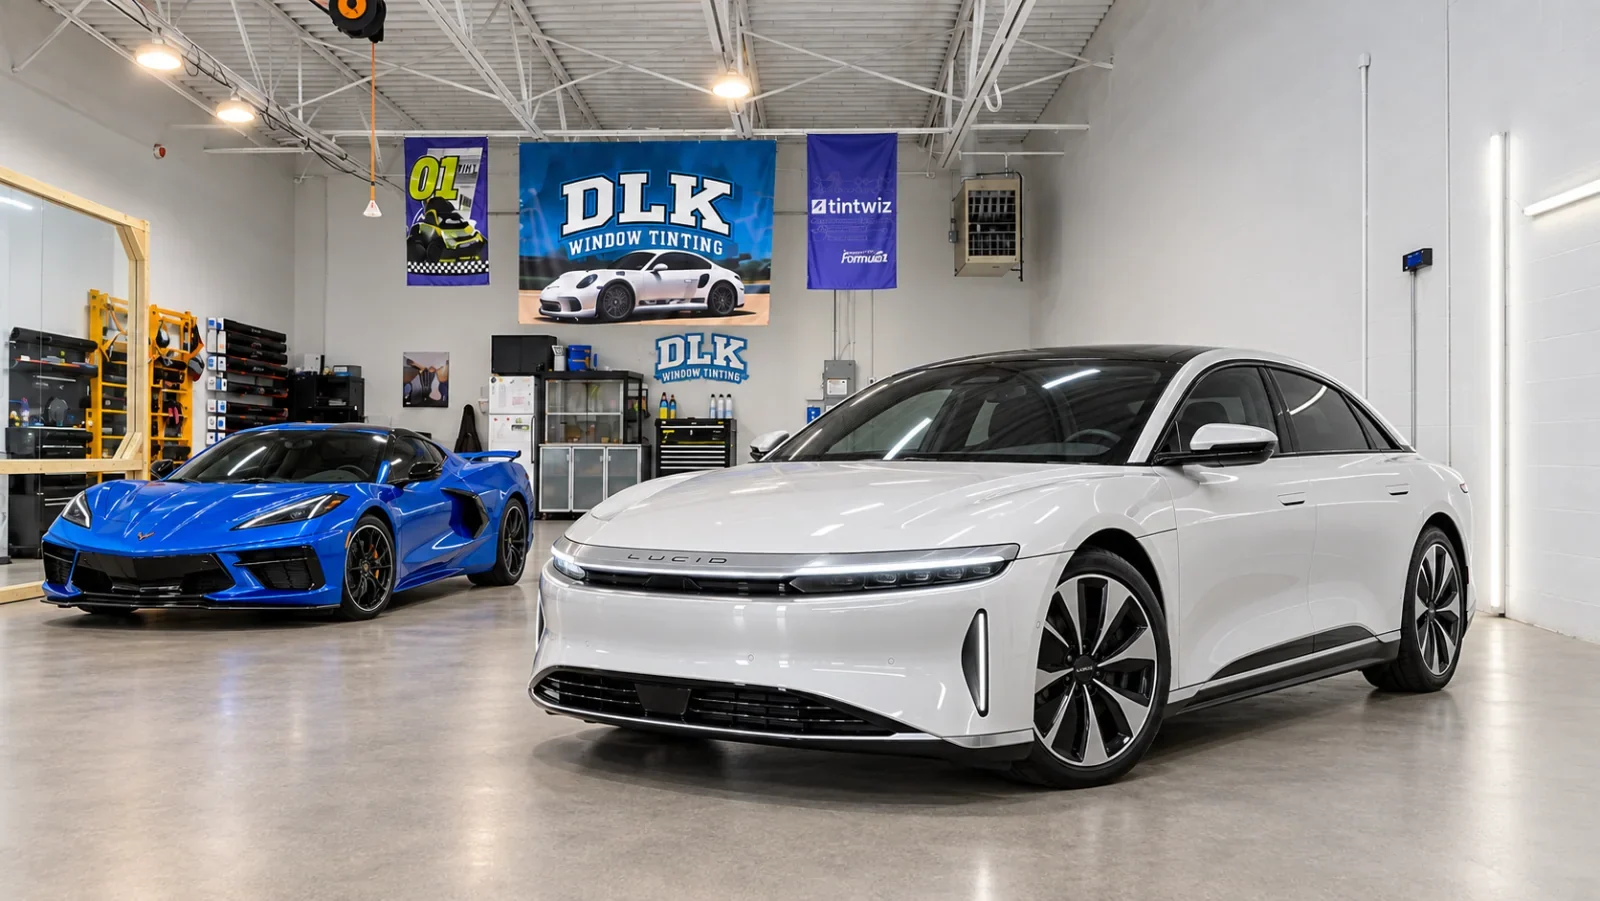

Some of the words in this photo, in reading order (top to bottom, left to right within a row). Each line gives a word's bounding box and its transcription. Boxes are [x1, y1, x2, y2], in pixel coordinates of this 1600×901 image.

[408, 156, 460, 201] 01
[561, 172, 732, 237] DLK
[828, 197, 892, 214] tintwiz
[568, 230, 642, 256] WINDOW
[649, 230, 724, 256] TINTING
[657, 334, 745, 371] DLK
[662, 368, 701, 382] WINDOW
[703, 368, 741, 382] TINTING
[627, 554, 728, 564] LUCID
